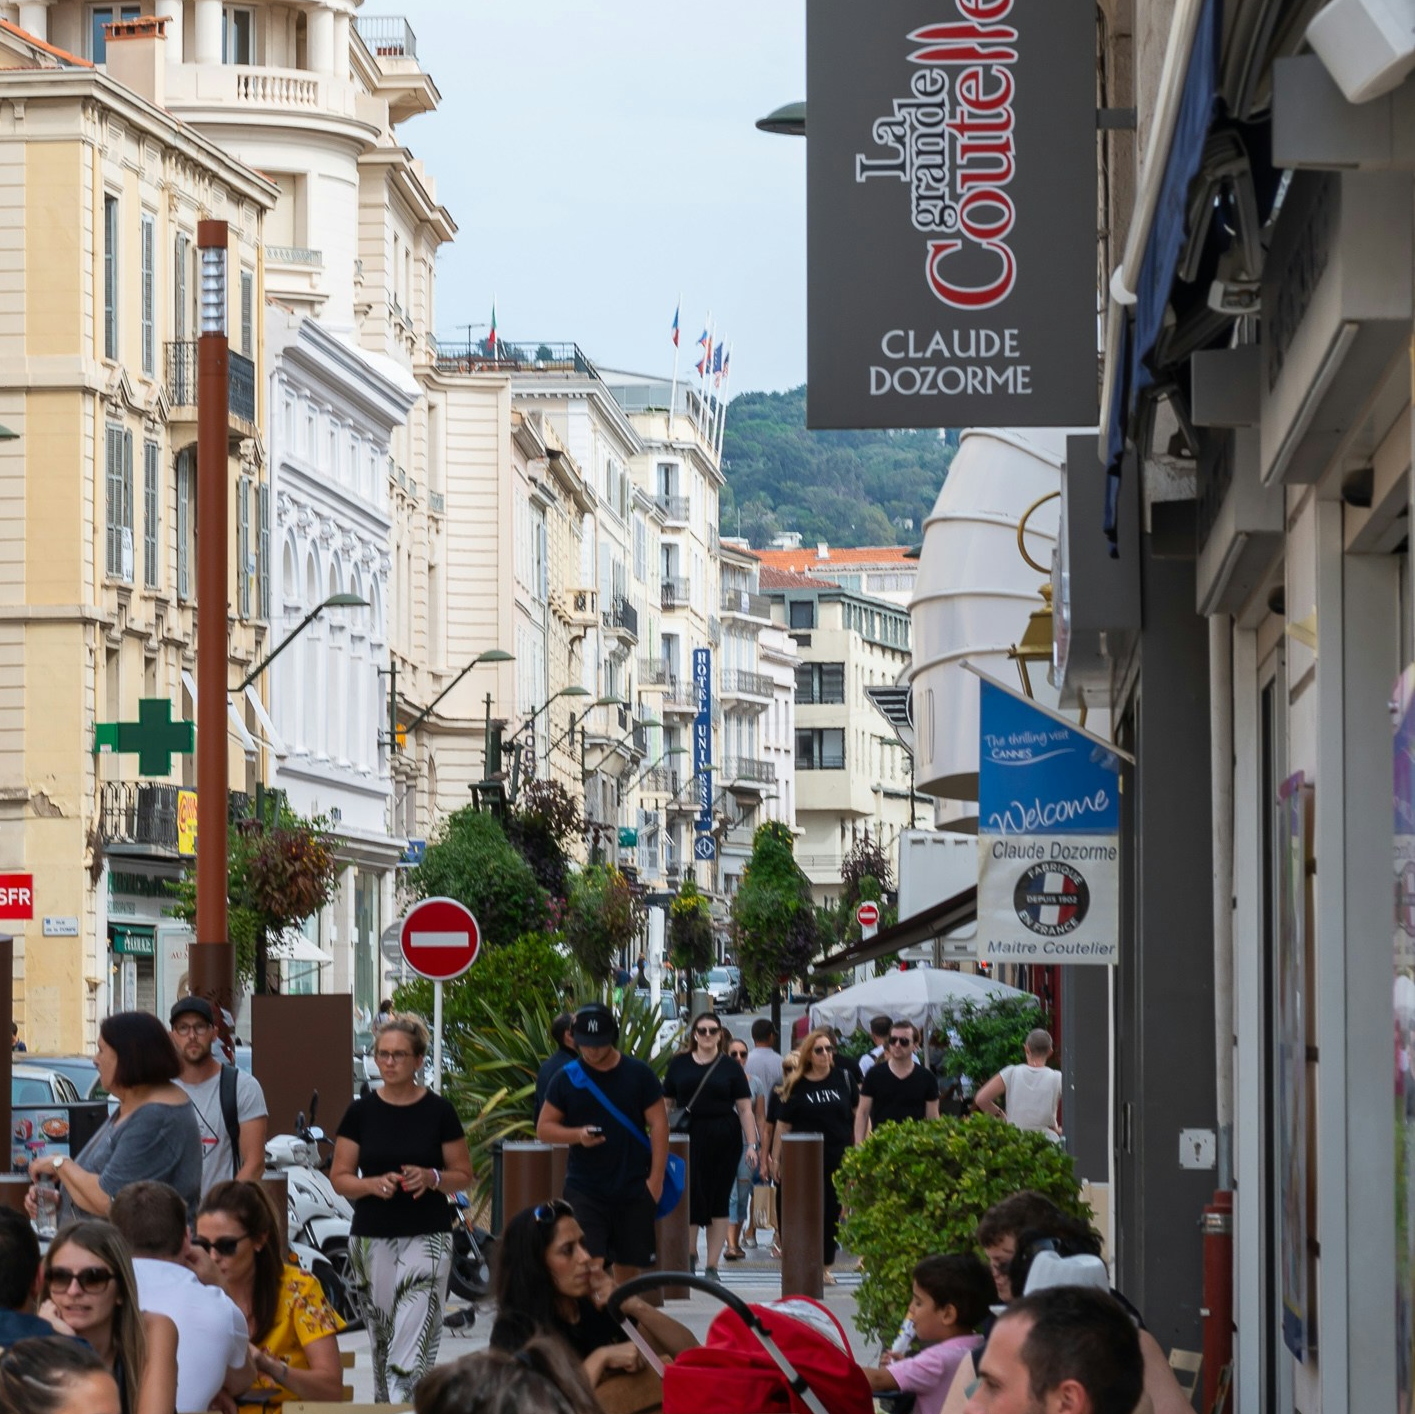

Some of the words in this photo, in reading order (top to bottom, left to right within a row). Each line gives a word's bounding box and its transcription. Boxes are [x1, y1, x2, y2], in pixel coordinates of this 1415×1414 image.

[856, 116, 910, 183] La
[893, 69, 958, 232] grande
[881, 329, 1021, 359] CLAUDE
[869, 365, 1032, 396] DOZORME
[985, 734, 1006, 748] The
[1008, 731, 1048, 747] thrilling
[991, 748, 1033, 759] CANNES
[989, 789, 1110, 836] Welcome
[992, 840, 1045, 860] Claude
[1050, 841, 1118, 861] Dozorme
[1027, 862, 1084, 886] FABRIQUE
[1026, 894, 1056, 904] DEPUIS
[1018, 909, 1032, 928] EN
[1033, 917, 1080, 936] FRANCE
[1043, 941, 1117, 956] Coutelier
